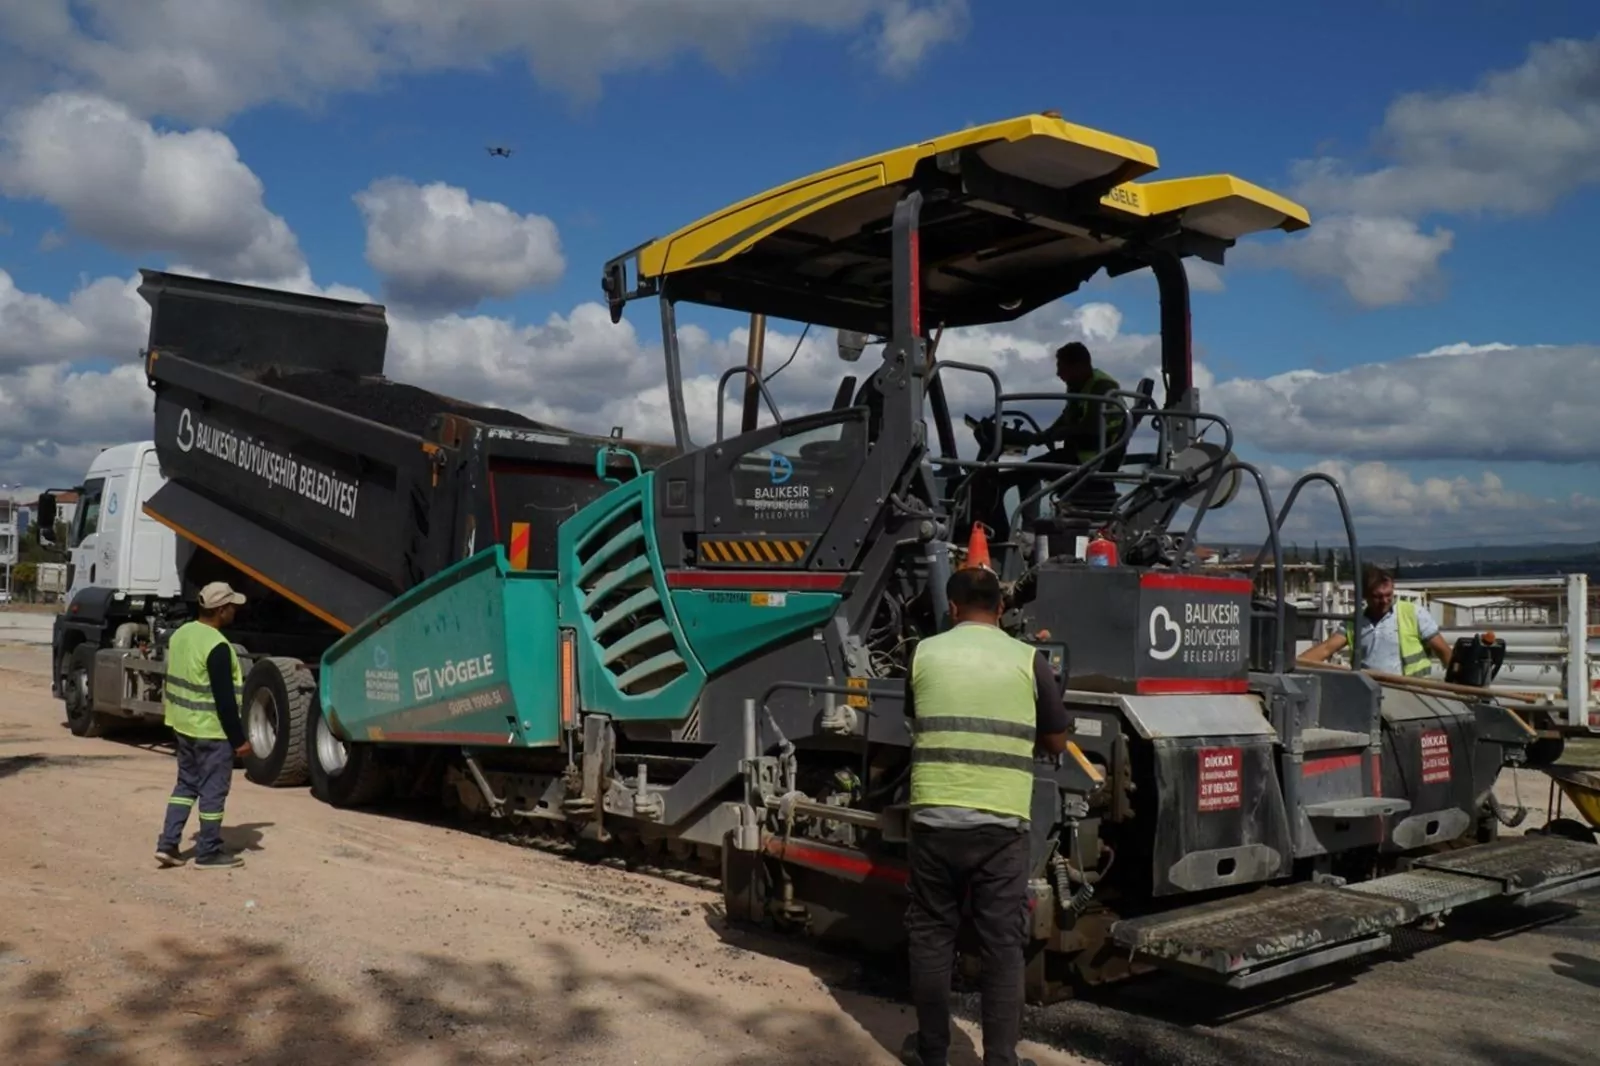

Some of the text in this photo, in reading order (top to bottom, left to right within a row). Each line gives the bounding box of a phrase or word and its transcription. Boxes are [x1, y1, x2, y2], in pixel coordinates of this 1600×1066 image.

[1109, 187, 1140, 208] GELE
[195, 422, 360, 519] BALIKESİR BÜYÜKŞEHİR BELEDİYESİ
[754, 484, 809, 498] BALIKESİR
[1185, 601, 1240, 624] BALIKESİR
[1184, 626, 1240, 649] BÜYÜKŞEHİR
[1183, 649, 1240, 662] BELEDİYESİ
[434, 653, 495, 689] VÖGELE
[1421, 735, 1447, 748] DİKKAT
[1204, 754, 1234, 768] DİKKAT
